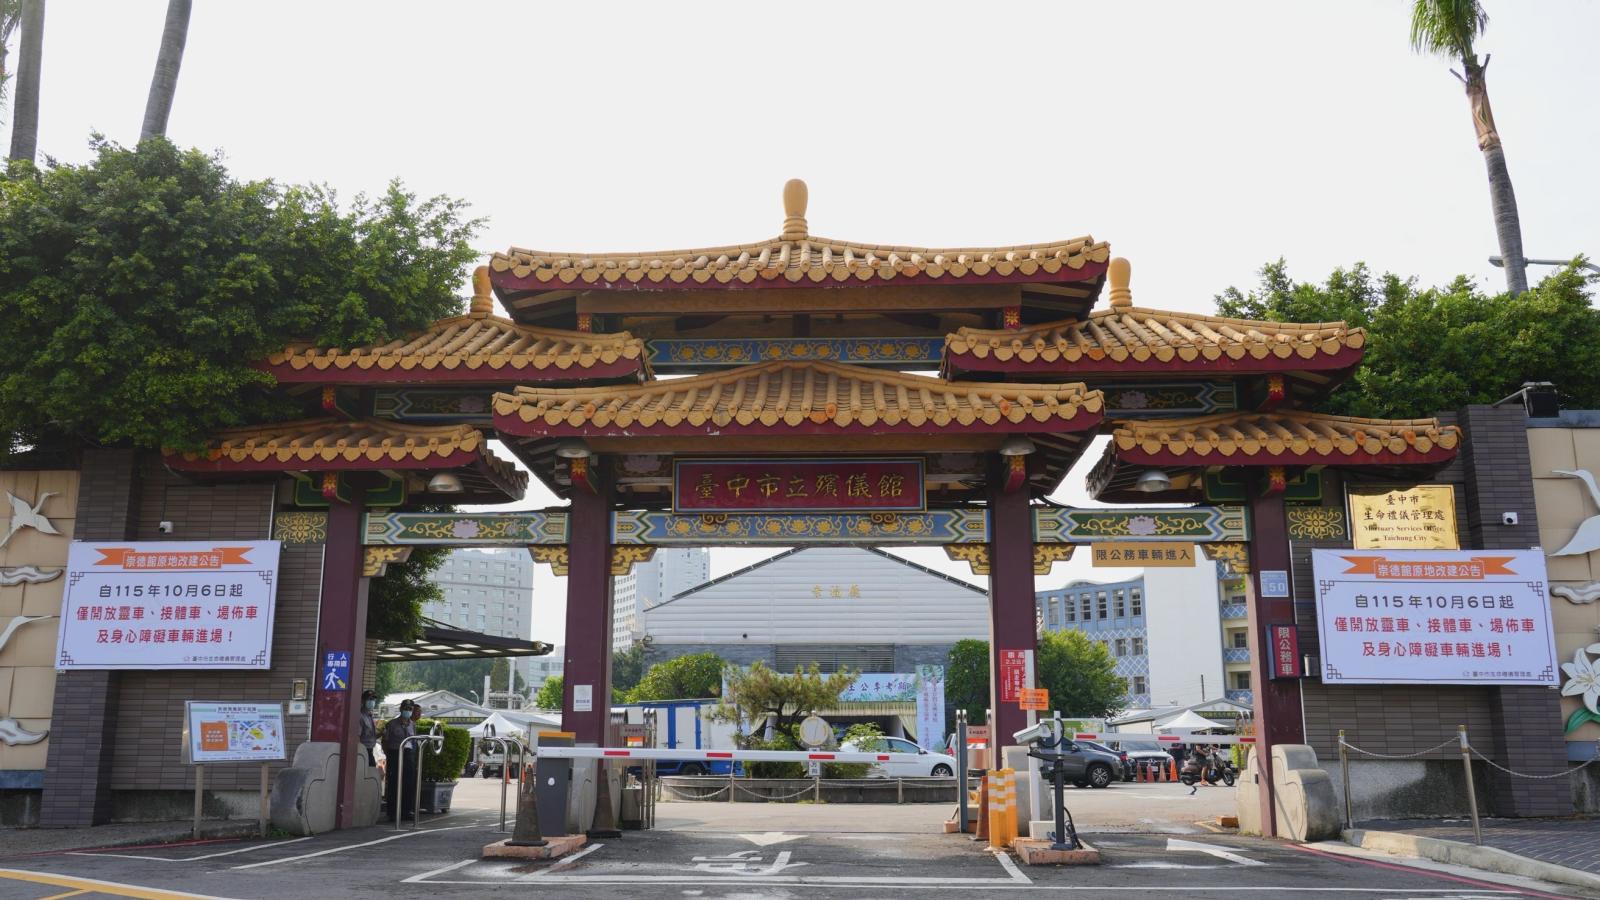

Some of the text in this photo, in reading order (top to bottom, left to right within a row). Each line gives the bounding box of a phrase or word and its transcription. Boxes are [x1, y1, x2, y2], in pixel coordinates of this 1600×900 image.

[695, 473, 905, 500] 臺中市立殯儀館
[1385, 494, 1420, 506] 臺中市
[1363, 509, 1446, 521] 生命禮儀管理處
[1096, 549, 1191, 561] 限公務車輛進入
[99, 584, 243, 598] 自115年10月6日起
[1354, 595, 1515, 609] 自115年10月6日起
[76, 605, 259, 621] 僅開放靈車、接體車、場佈車
[1333, 617, 1536, 633] 僅開放靈車、接體車、場佈車
[1278, 626, 1294, 676] 限公務車
